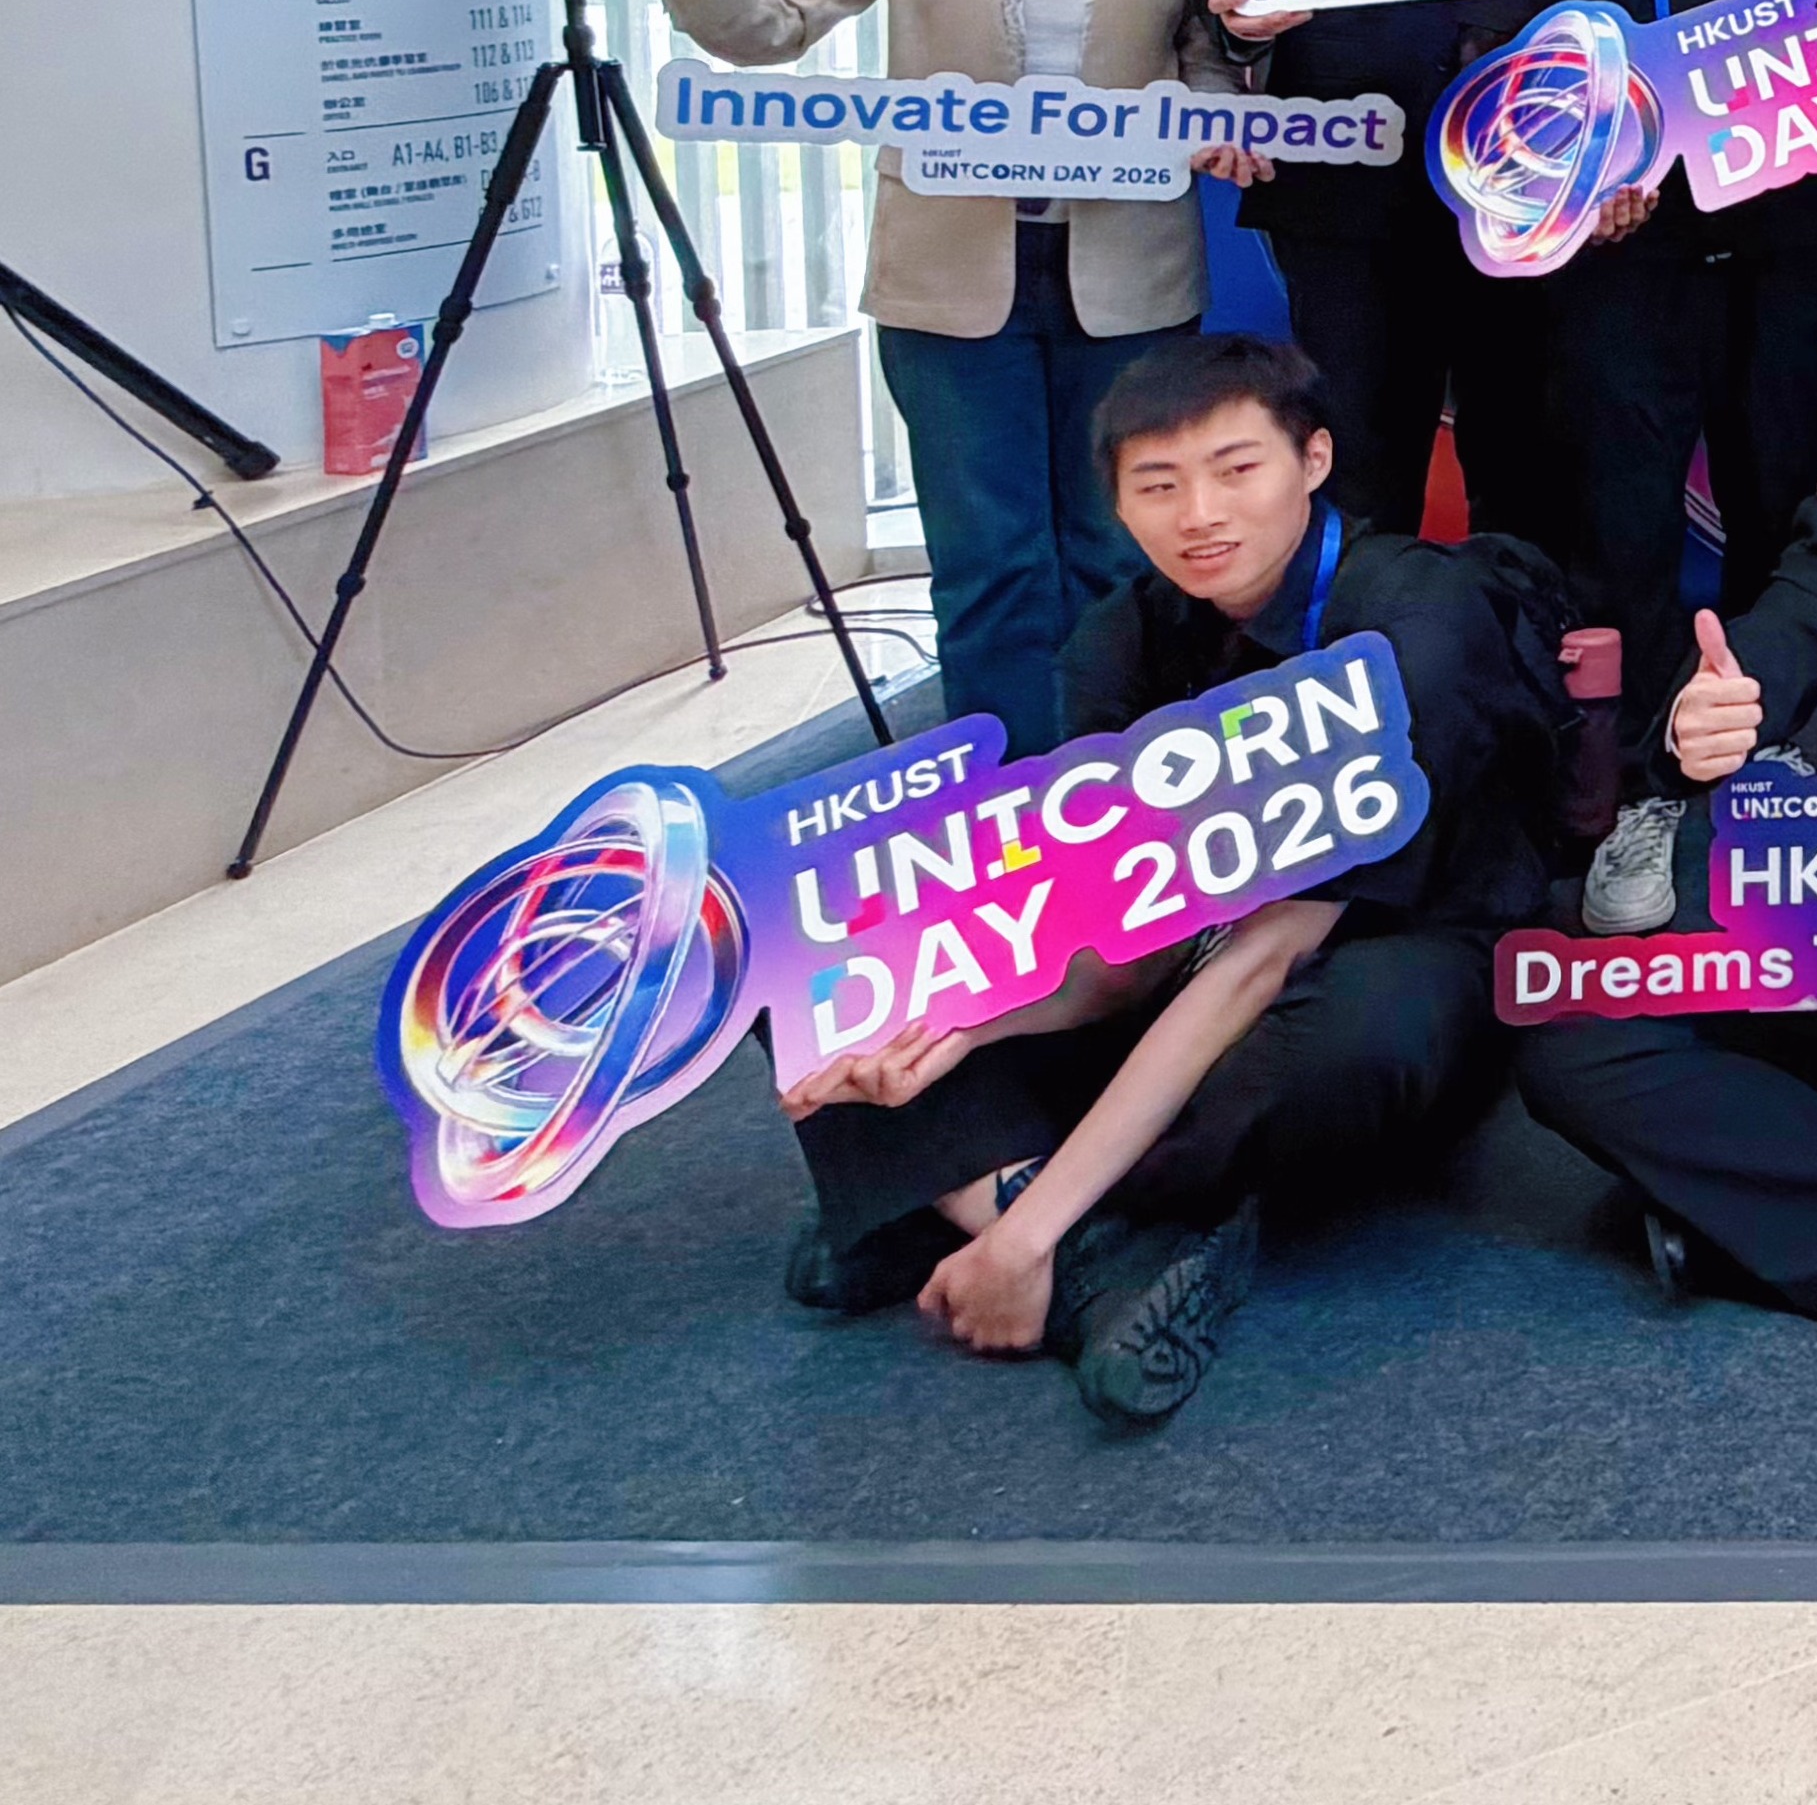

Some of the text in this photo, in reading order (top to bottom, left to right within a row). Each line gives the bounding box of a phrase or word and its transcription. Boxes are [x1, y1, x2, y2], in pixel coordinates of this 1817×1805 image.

[470, 7, 493, 30] 111
[472, 45, 497, 68] 112
[676, 77, 1386, 151] Innovate For Impact
[245, 147, 270, 181] G
[327, 150, 355, 162] 入口
[922, 161, 1172, 185] UNICORN DAY 2026
[788, 744, 973, 848] HKUST
[797, 659, 1379, 945] UNICORN
[1731, 781, 1773, 793] HKUST
[808, 756, 1398, 1056] DAY 2026
[1515, 947, 1793, 1004] Dreams
